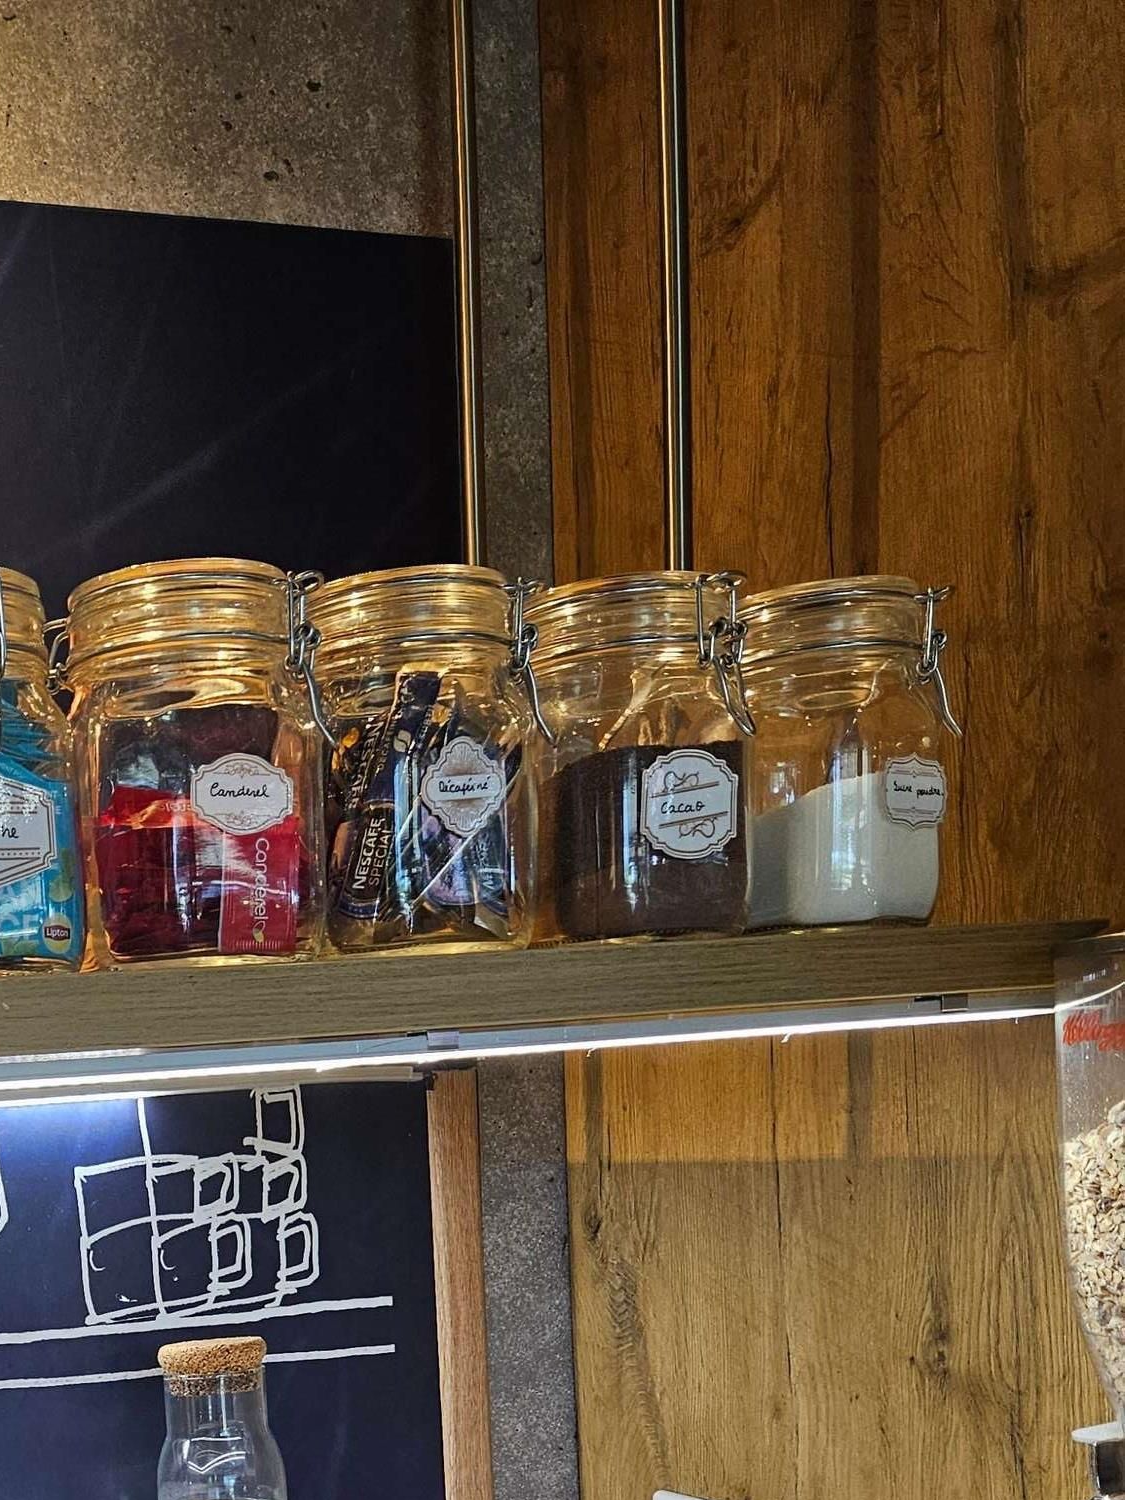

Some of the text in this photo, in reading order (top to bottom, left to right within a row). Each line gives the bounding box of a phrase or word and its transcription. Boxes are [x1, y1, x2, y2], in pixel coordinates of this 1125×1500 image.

[209, 782, 270, 798] Canderel
[660, 800, 706, 814] Cacao
[254, 837, 270, 920] Canderel
[45, 926, 69, 939] Lipton
